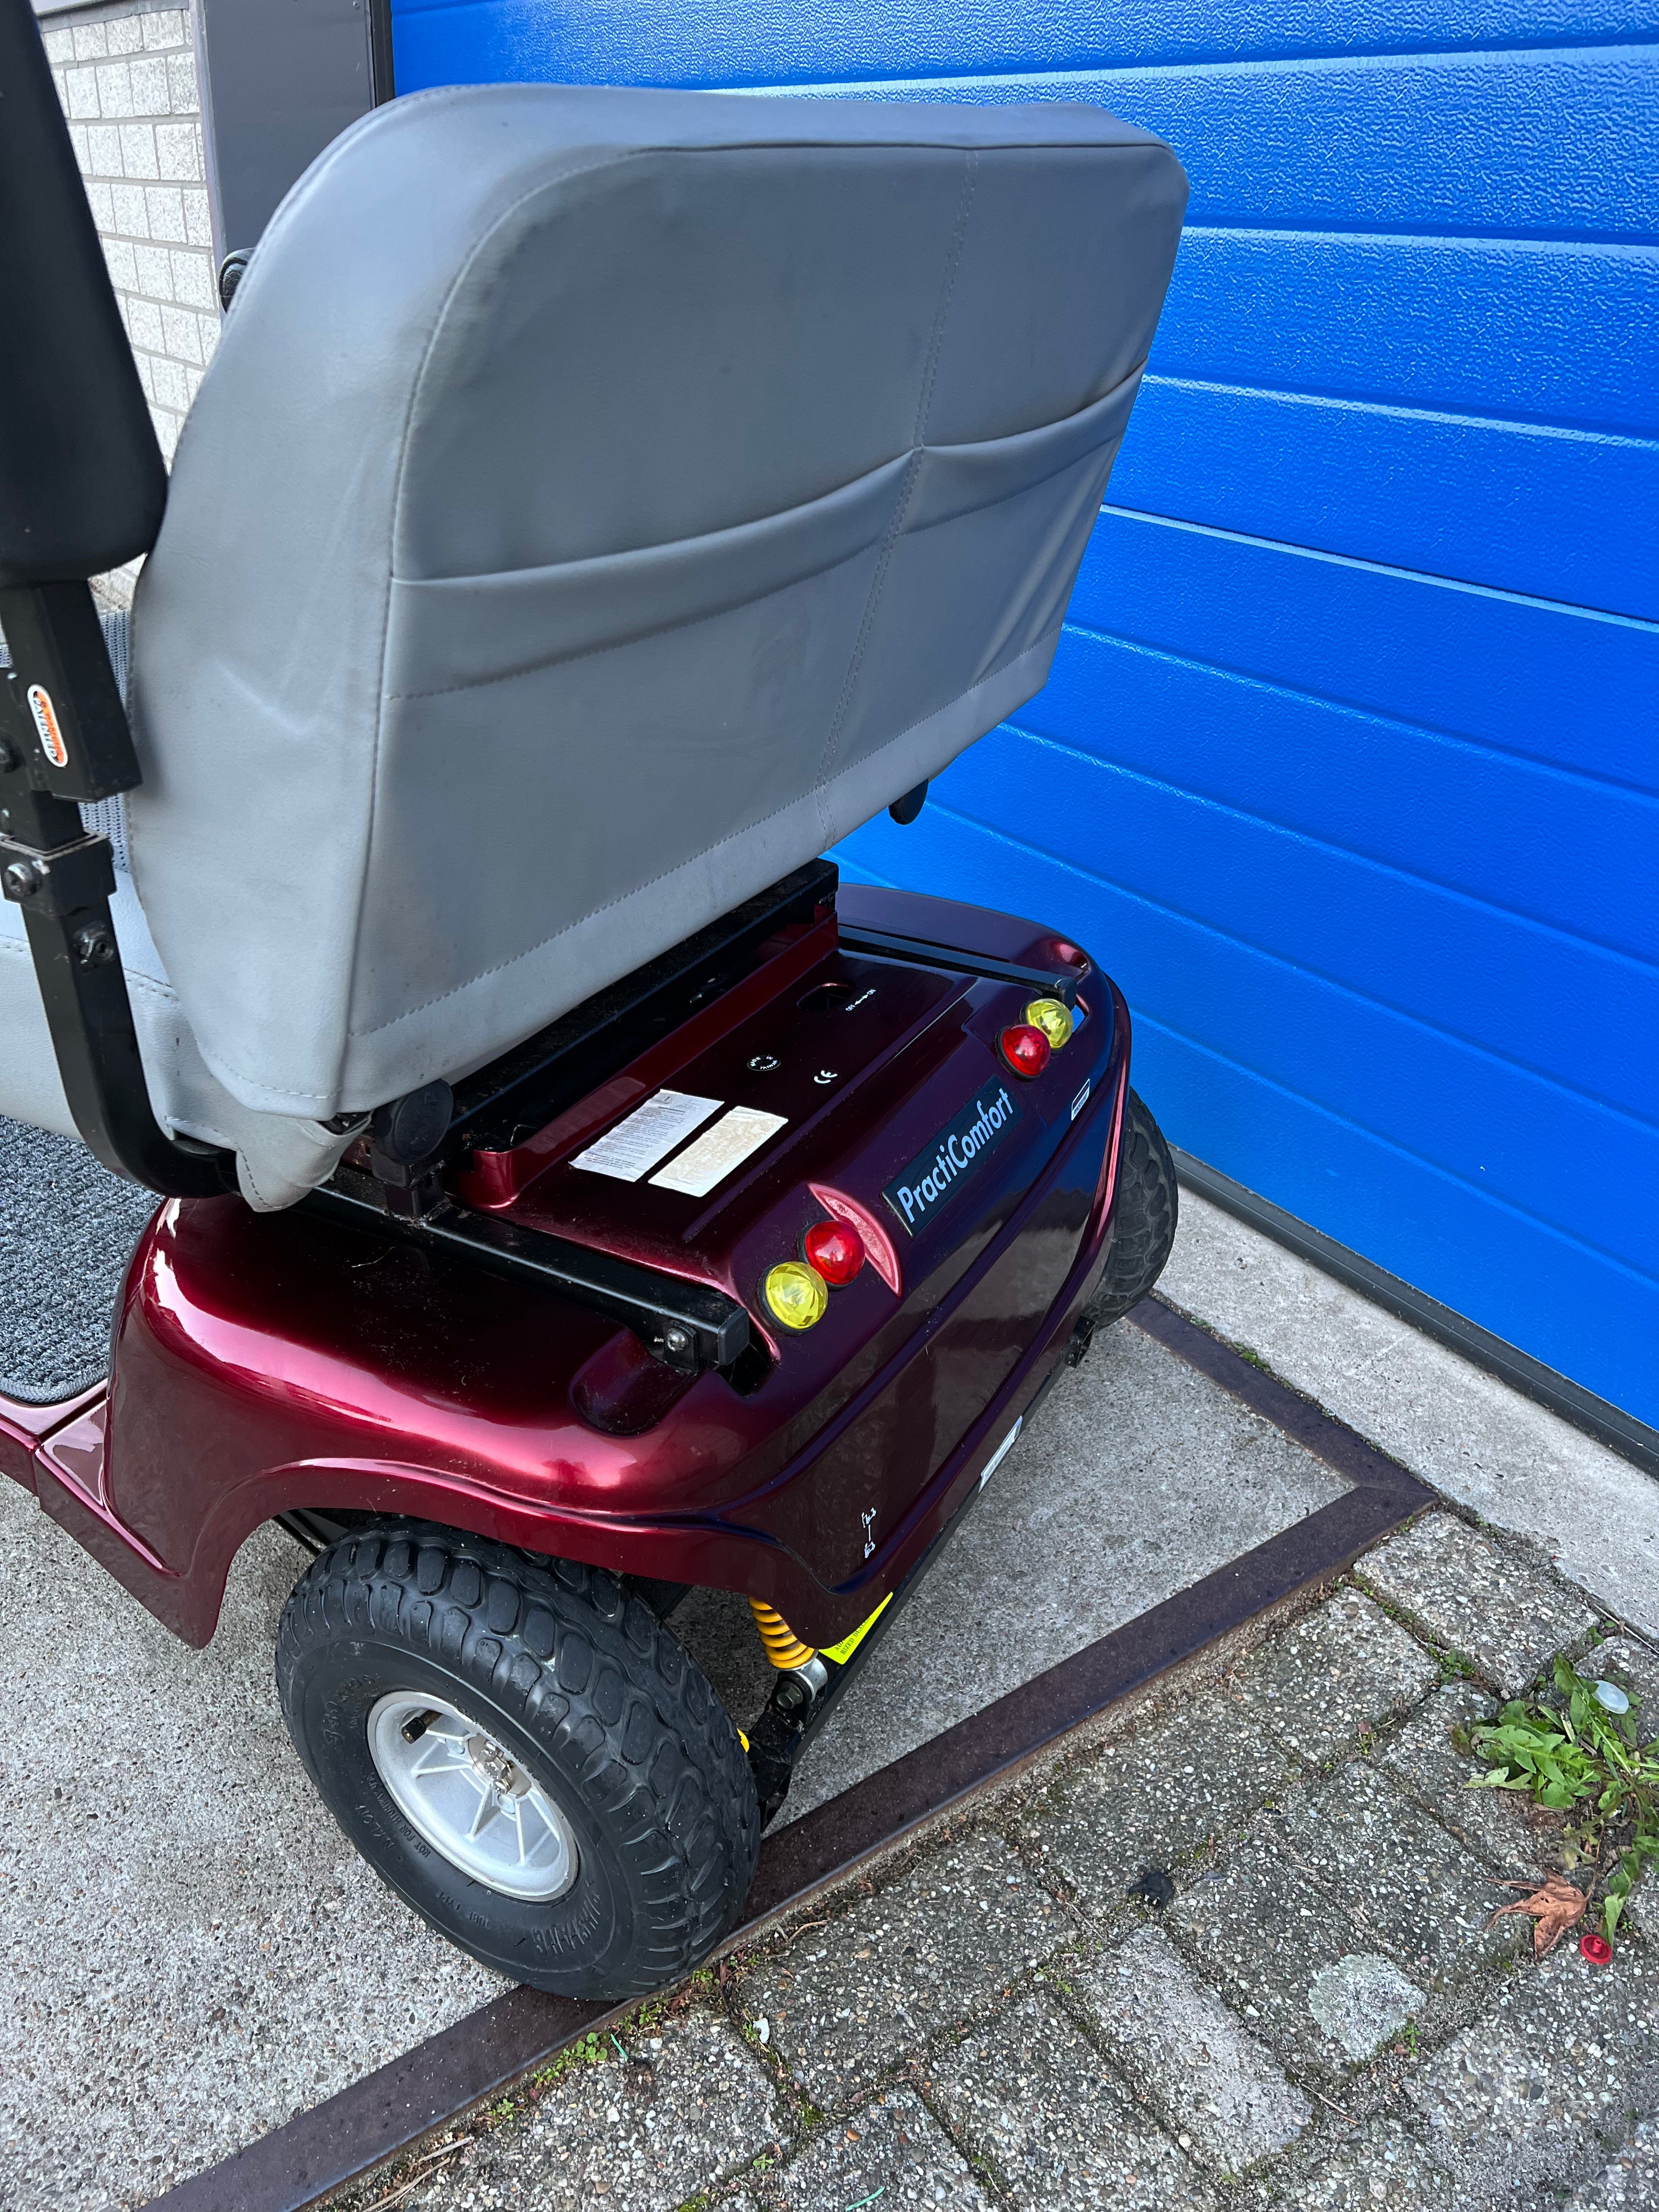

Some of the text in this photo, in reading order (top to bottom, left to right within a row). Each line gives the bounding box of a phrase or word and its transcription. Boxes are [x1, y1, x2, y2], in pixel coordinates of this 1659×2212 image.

[33, 697, 58, 758] PATENTED
[749, 1056, 761, 1067] MADE
[814, 1070, 838, 1084] CE
[896, 1087, 1014, 1224] PractiComfort
[840, 1638, 855, 1655] RIZED
[355, 1804, 395, 1852] NYLON
[399, 1824, 416, 1842] FOR
[413, 1841, 431, 1859] NOT
